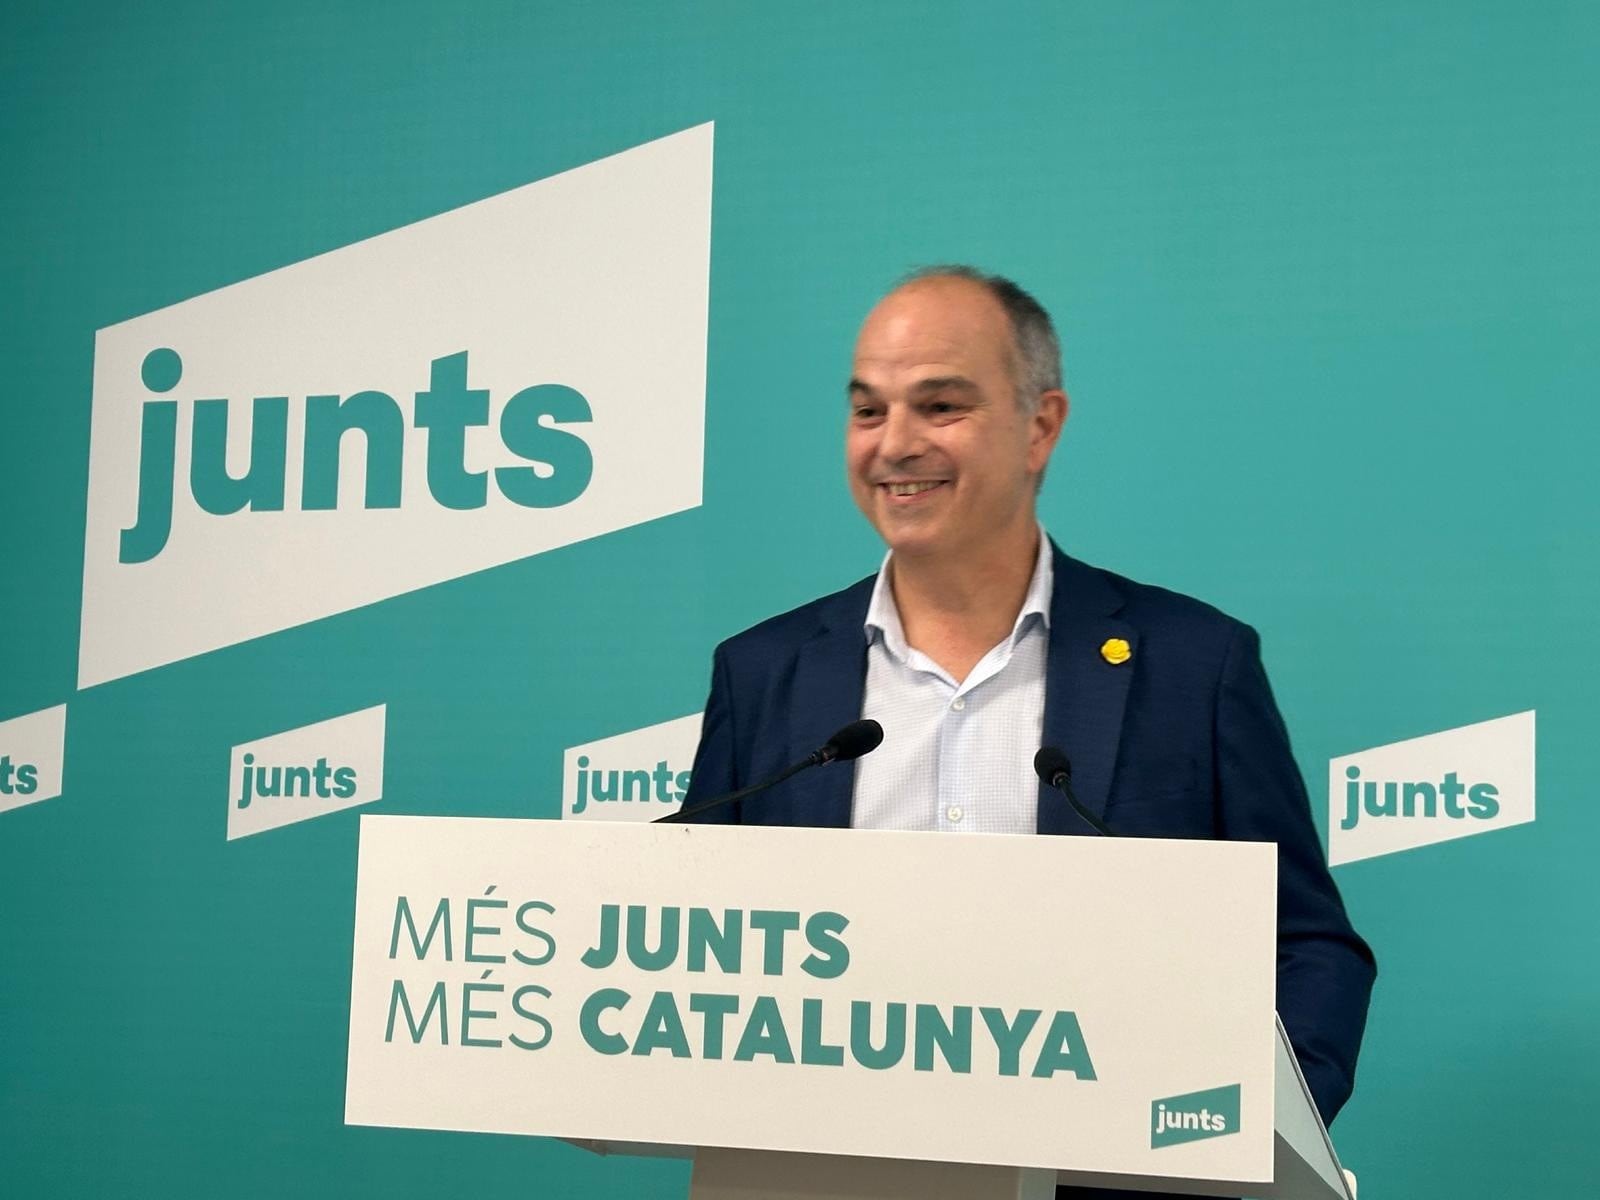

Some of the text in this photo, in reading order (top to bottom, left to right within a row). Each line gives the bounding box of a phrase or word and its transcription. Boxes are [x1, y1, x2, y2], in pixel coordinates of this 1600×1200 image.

[119, 348, 593, 564] junts
[238, 753, 356, 809] junts
[1341, 766, 1500, 830] junts
[389, 885, 850, 979] MÉS JUNTS
[384, 969, 1098, 1081] MÉS CATALUNYA
[1156, 1103, 1226, 1134] junts
